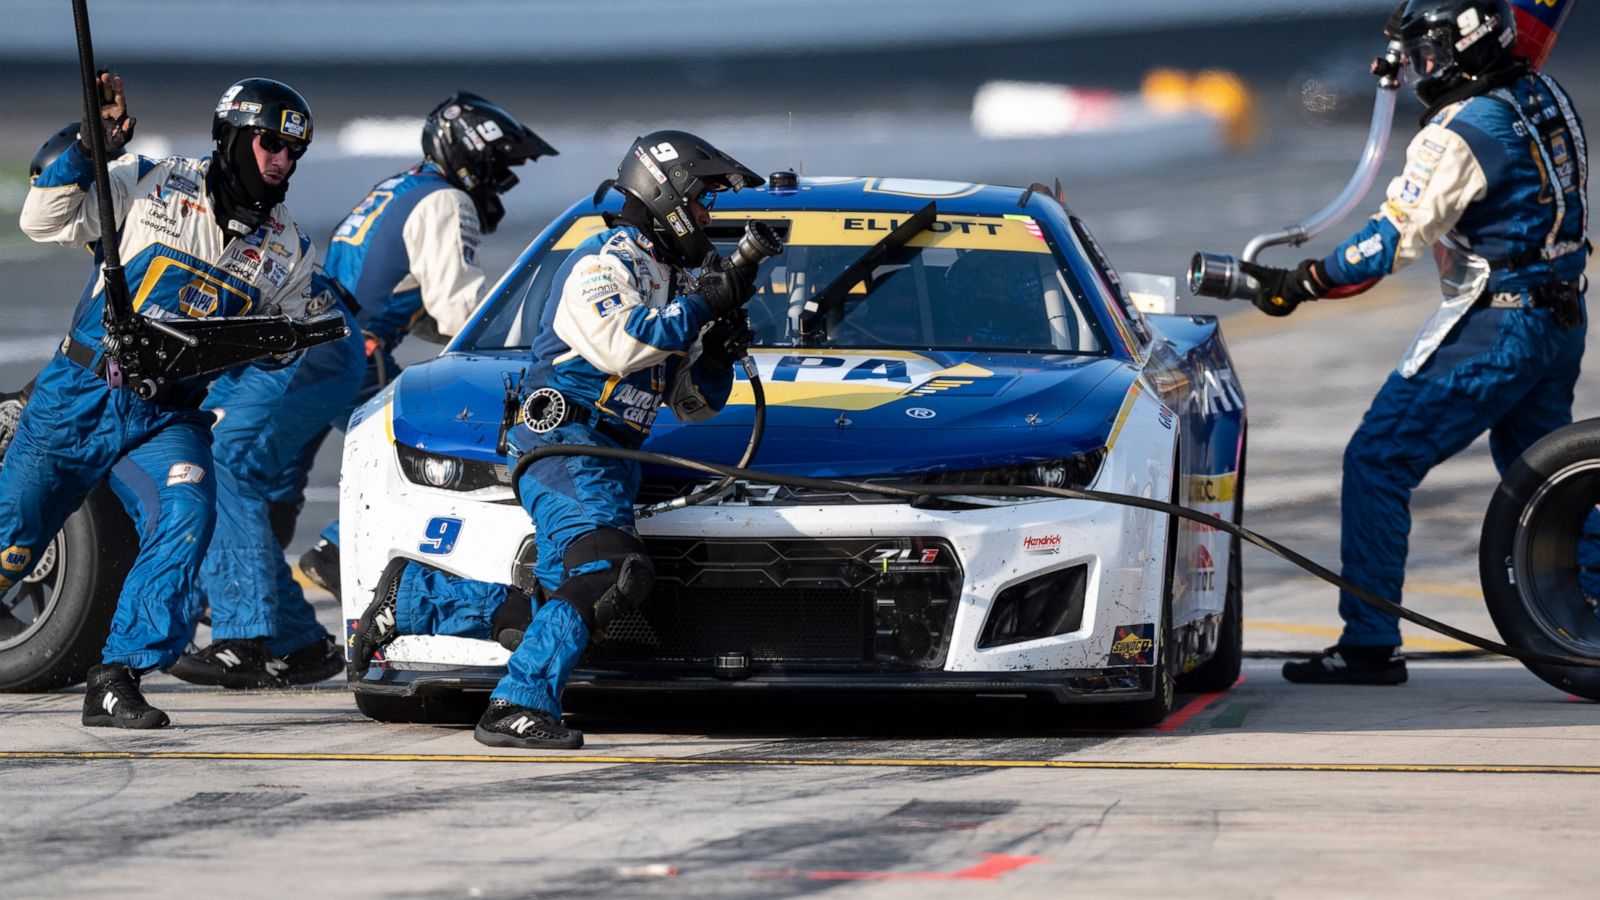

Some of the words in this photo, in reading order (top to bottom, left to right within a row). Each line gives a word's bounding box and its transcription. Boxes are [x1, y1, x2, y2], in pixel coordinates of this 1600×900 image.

[1456, 7, 1480, 36] 9
[476, 120, 504, 142] 9
[649, 142, 679, 162] 9
[149, 208, 176, 226] UniFirst
[675, 205, 695, 234] PREDATOR
[844, 218, 1003, 235] ELLOTT
[141, 219, 180, 238] GOODYEAR
[182, 285, 214, 312] NAPA
[582, 283, 619, 296] Acronis
[614, 384, 653, 409] AUTO
[419, 516, 465, 556] 9
[1023, 534, 1061, 549] Hendrick
[6, 552, 27, 566] NAPA
[869, 549, 939, 563] ZL1
[1112, 640, 1152, 652] SUNOCO
